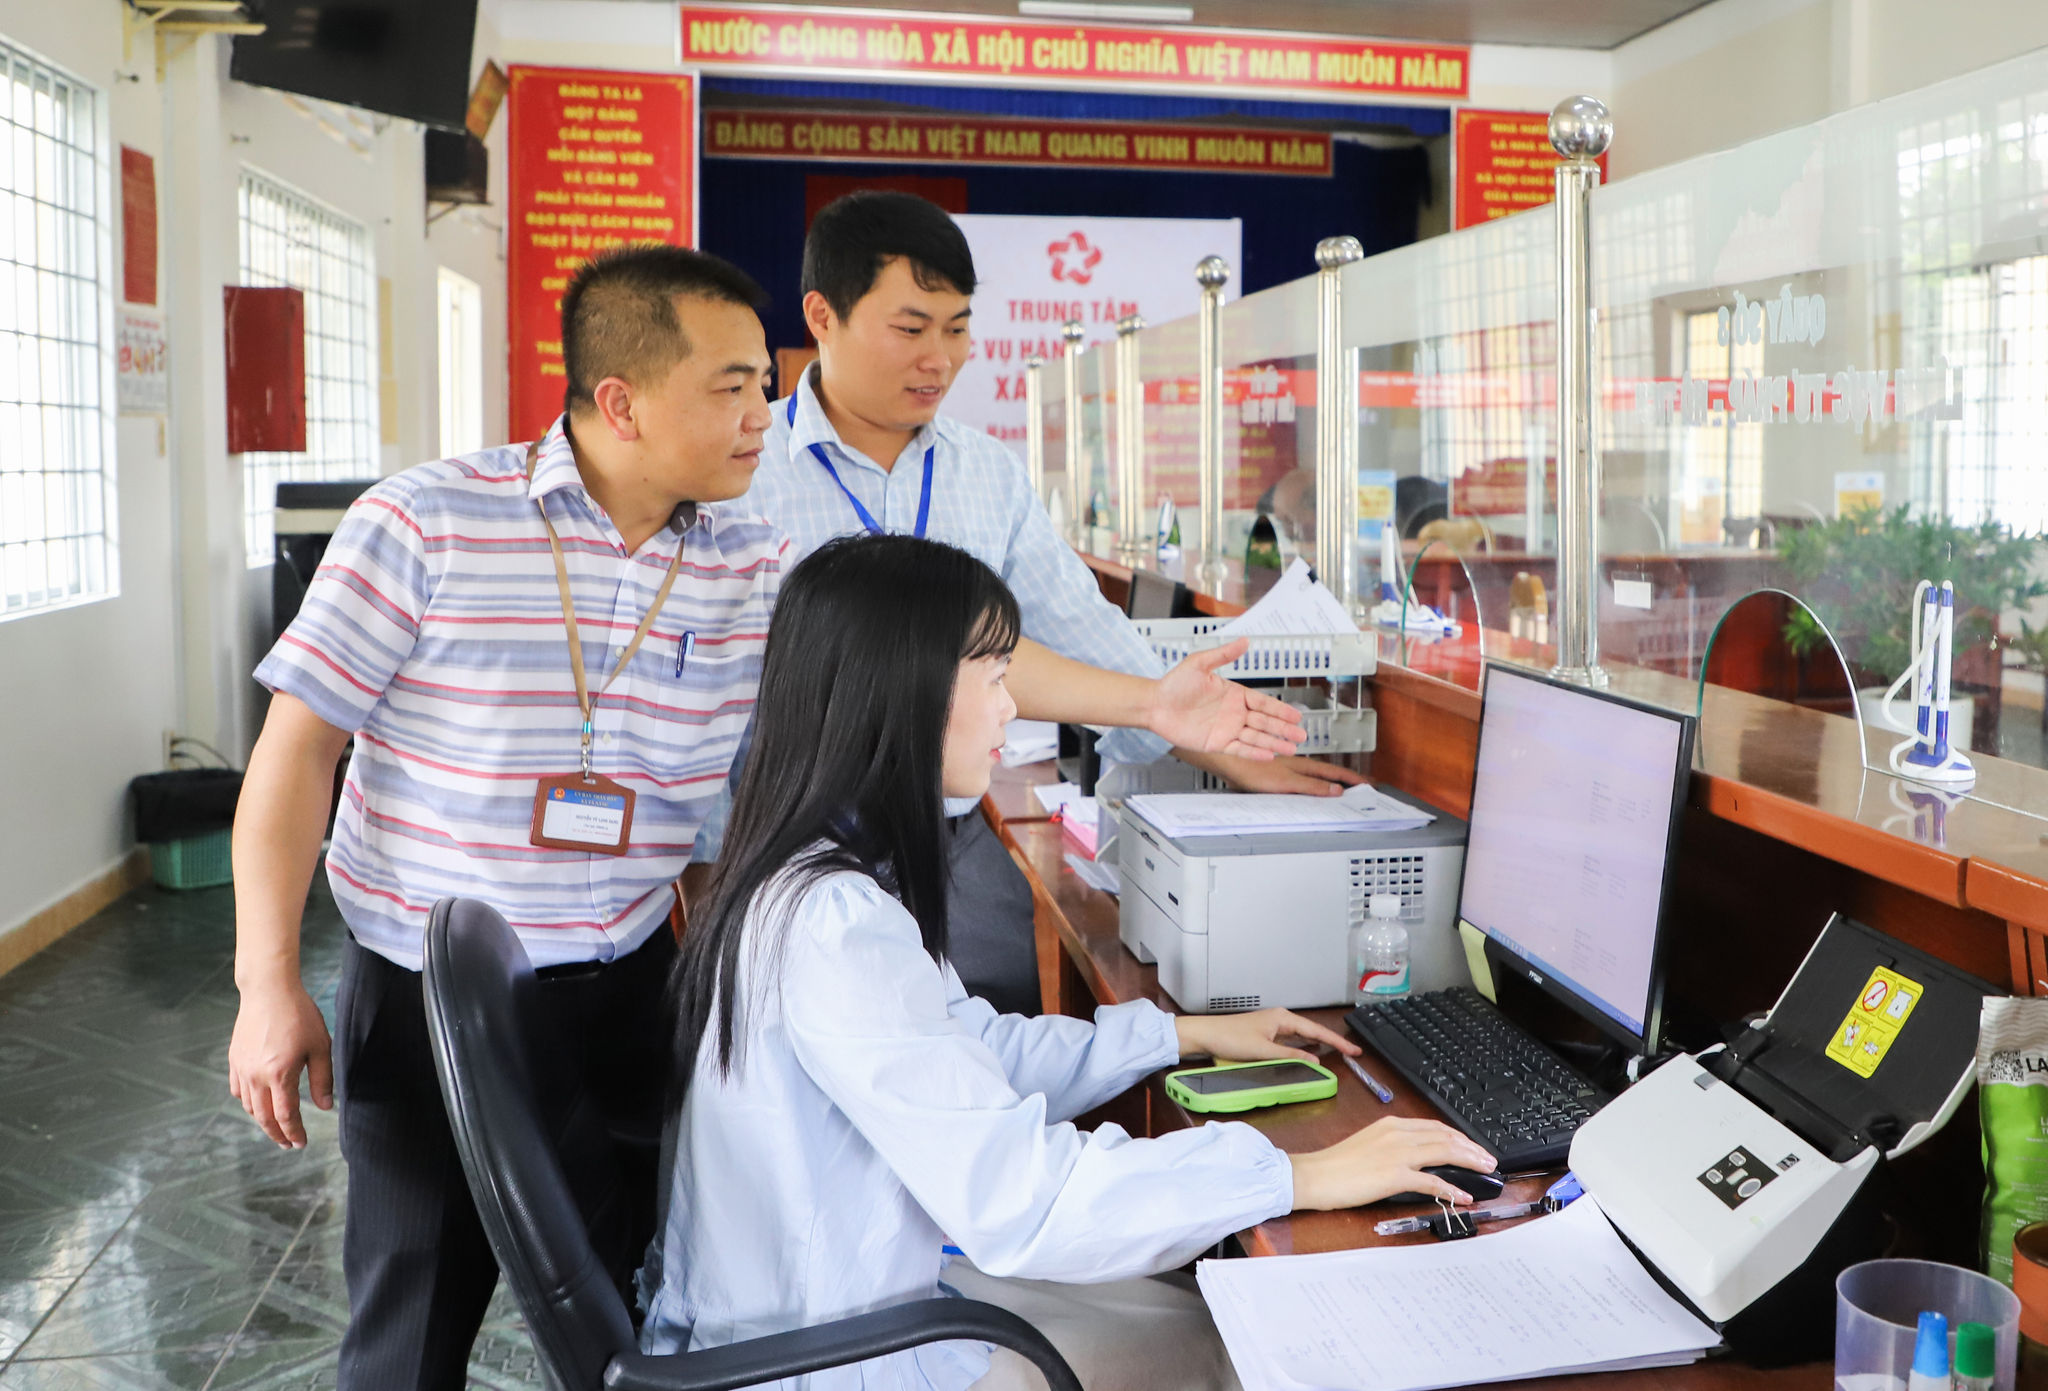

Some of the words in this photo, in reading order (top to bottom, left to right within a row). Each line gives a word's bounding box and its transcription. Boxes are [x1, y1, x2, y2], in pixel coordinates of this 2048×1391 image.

[689, 16, 771, 56] NƯỚC
[778, 18, 859, 63] CỘNG
[931, 27, 971, 65] XÃ
[977, 29, 1025, 73] HỘI
[1031, 29, 1089, 70] CHỦ
[1095, 38, 1180, 75] NGHĨA
[1185, 40, 1243, 83] VIỆT
[1248, 48, 1311, 80] NAM
[1317, 48, 1396, 85] MUÔN
[1402, 52, 1462, 89] NĂM
[715, 113, 785, 148] ĐẢNG
[792, 119, 861, 154] CỘNG
[868, 117, 920, 152] SẢN
[926, 124, 977, 160] VIỆT
[984, 130, 1041, 156] NAM
[1047, 131, 1128, 159] QUANG
[1133, 135, 1189, 160] VINH
[1195, 134, 1265, 164] MUÔN
[1270, 137, 1325, 166] NĂM
[1008, 300, 1083, 322] TRUNG
[1091, 296, 1139, 323] TÂM
[984, 339, 1012, 366] VỤ
[1020, 334, 1066, 360] HÀN
